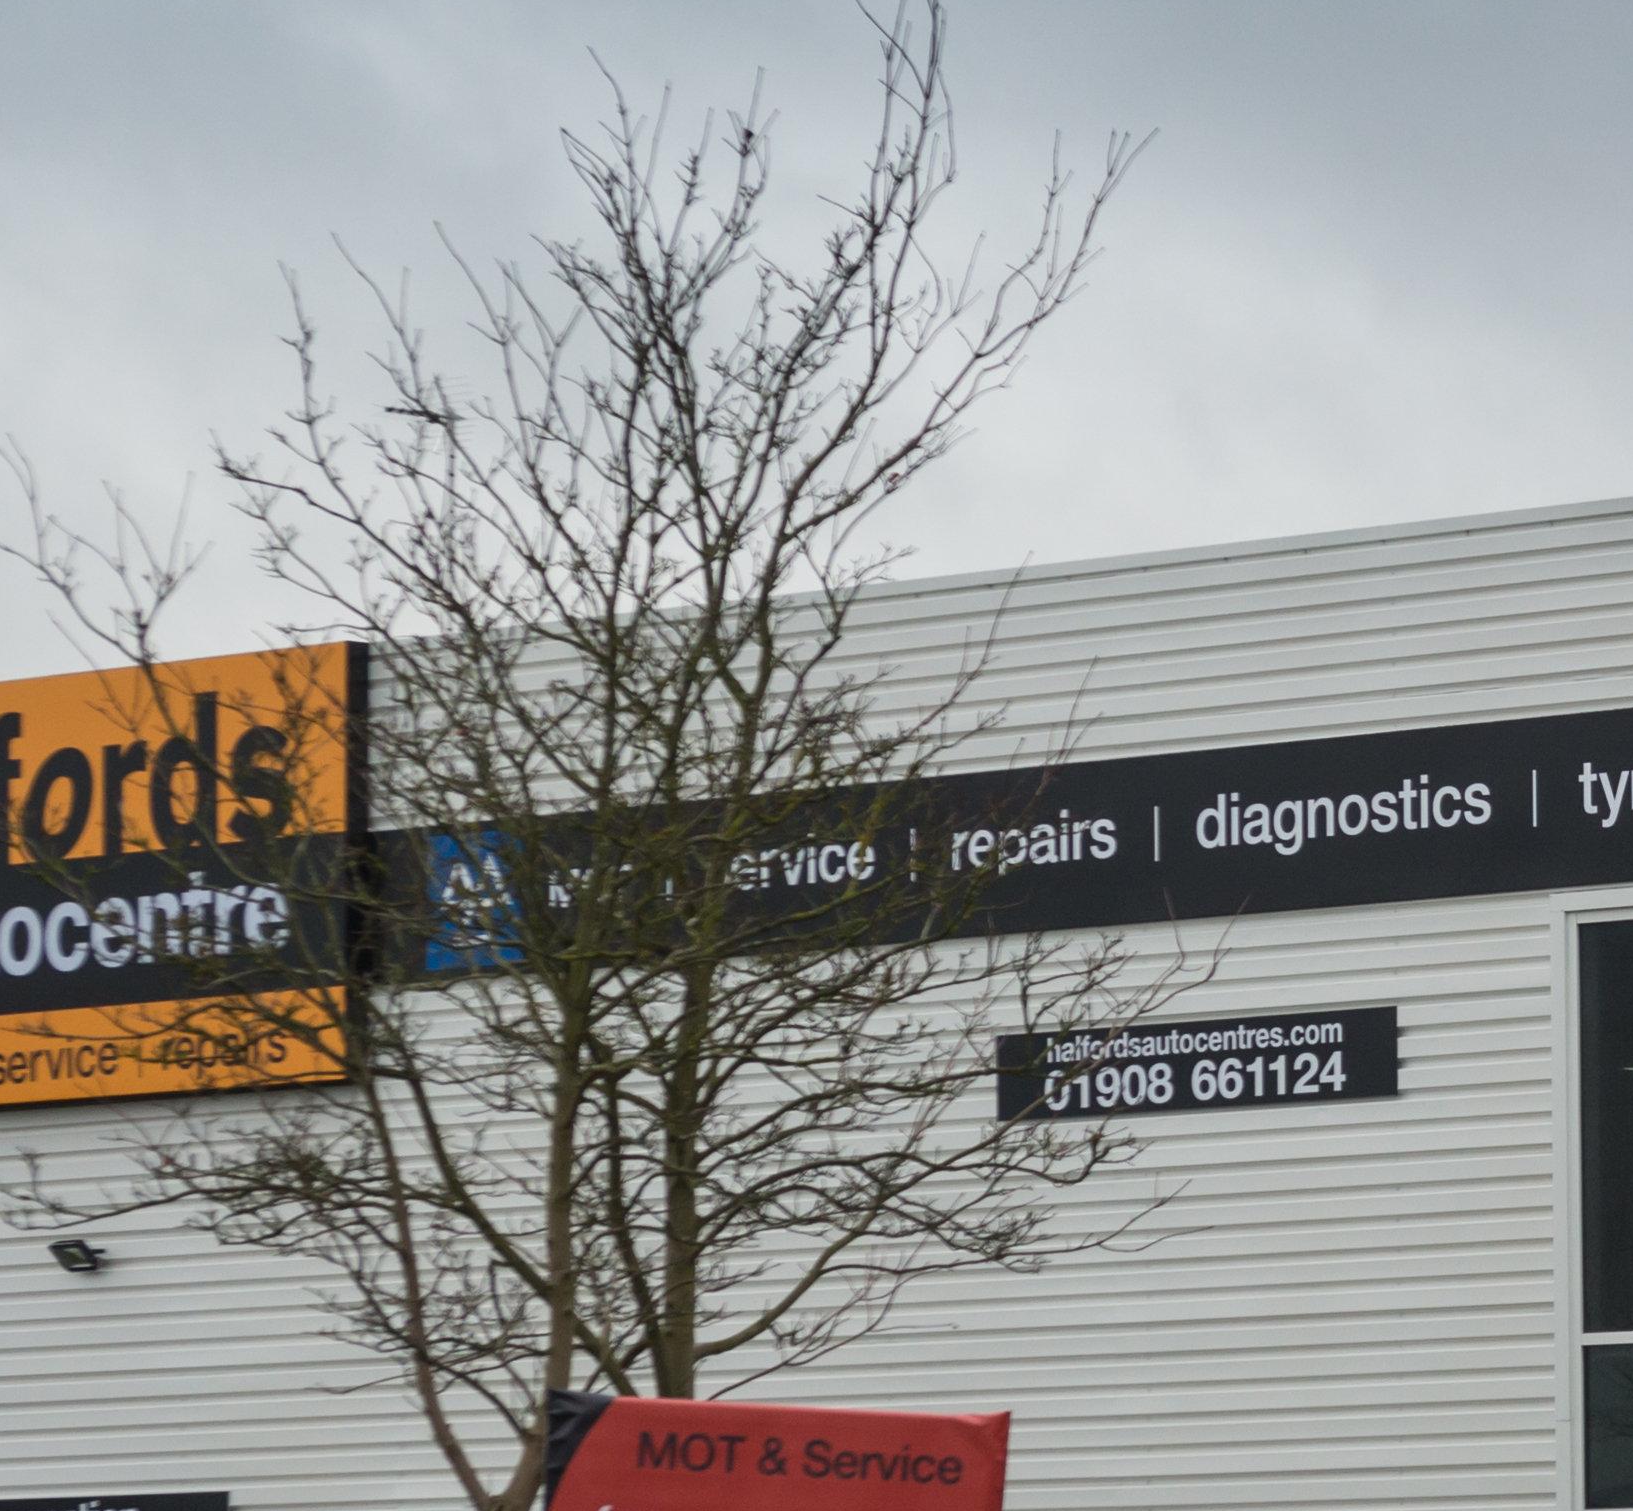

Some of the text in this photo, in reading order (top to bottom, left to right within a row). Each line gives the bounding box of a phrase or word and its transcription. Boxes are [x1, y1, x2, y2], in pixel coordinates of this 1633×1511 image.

[1195, 773, 1493, 856] diagnostics
[725, 808, 1117, 891] ervice repairs
[1046, 1021, 1344, 1064] halfordsautocentres.com
[1043, 1050, 1347, 1112] 01908 661124
[635, 1431, 964, 1486] MOT & Service
